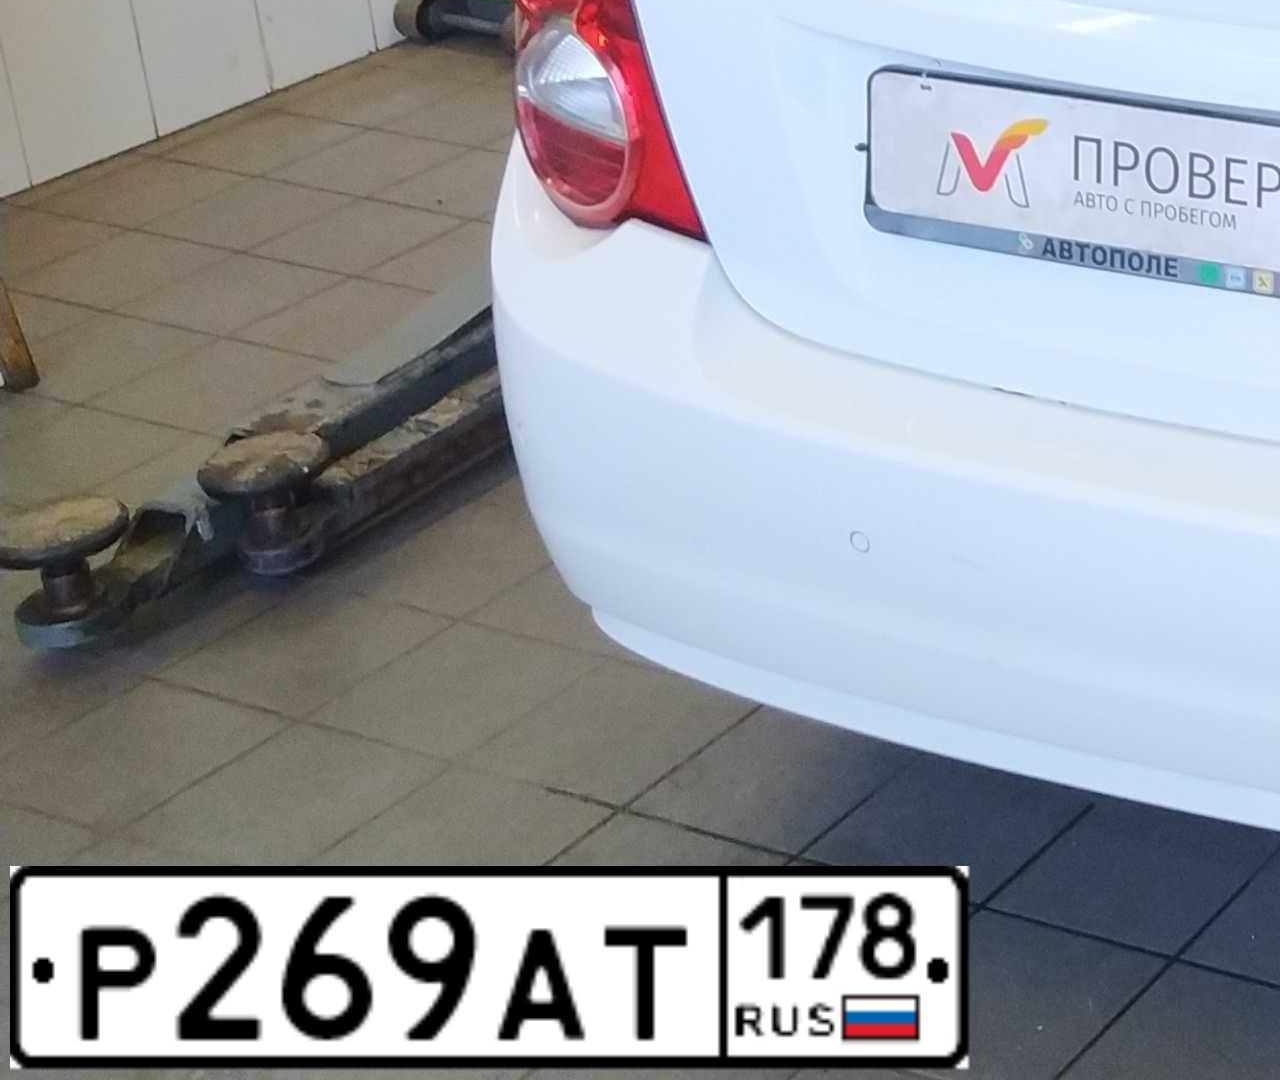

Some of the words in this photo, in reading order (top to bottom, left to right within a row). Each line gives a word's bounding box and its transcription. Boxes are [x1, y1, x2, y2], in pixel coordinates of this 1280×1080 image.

[1073, 190, 1118, 212] АВТО
[1124, 198, 1135, 215] С
[1140, 200, 1237, 230] ПРОБЕГОМ
[1042, 237, 1179, 278] АВТОПОЛЕ
